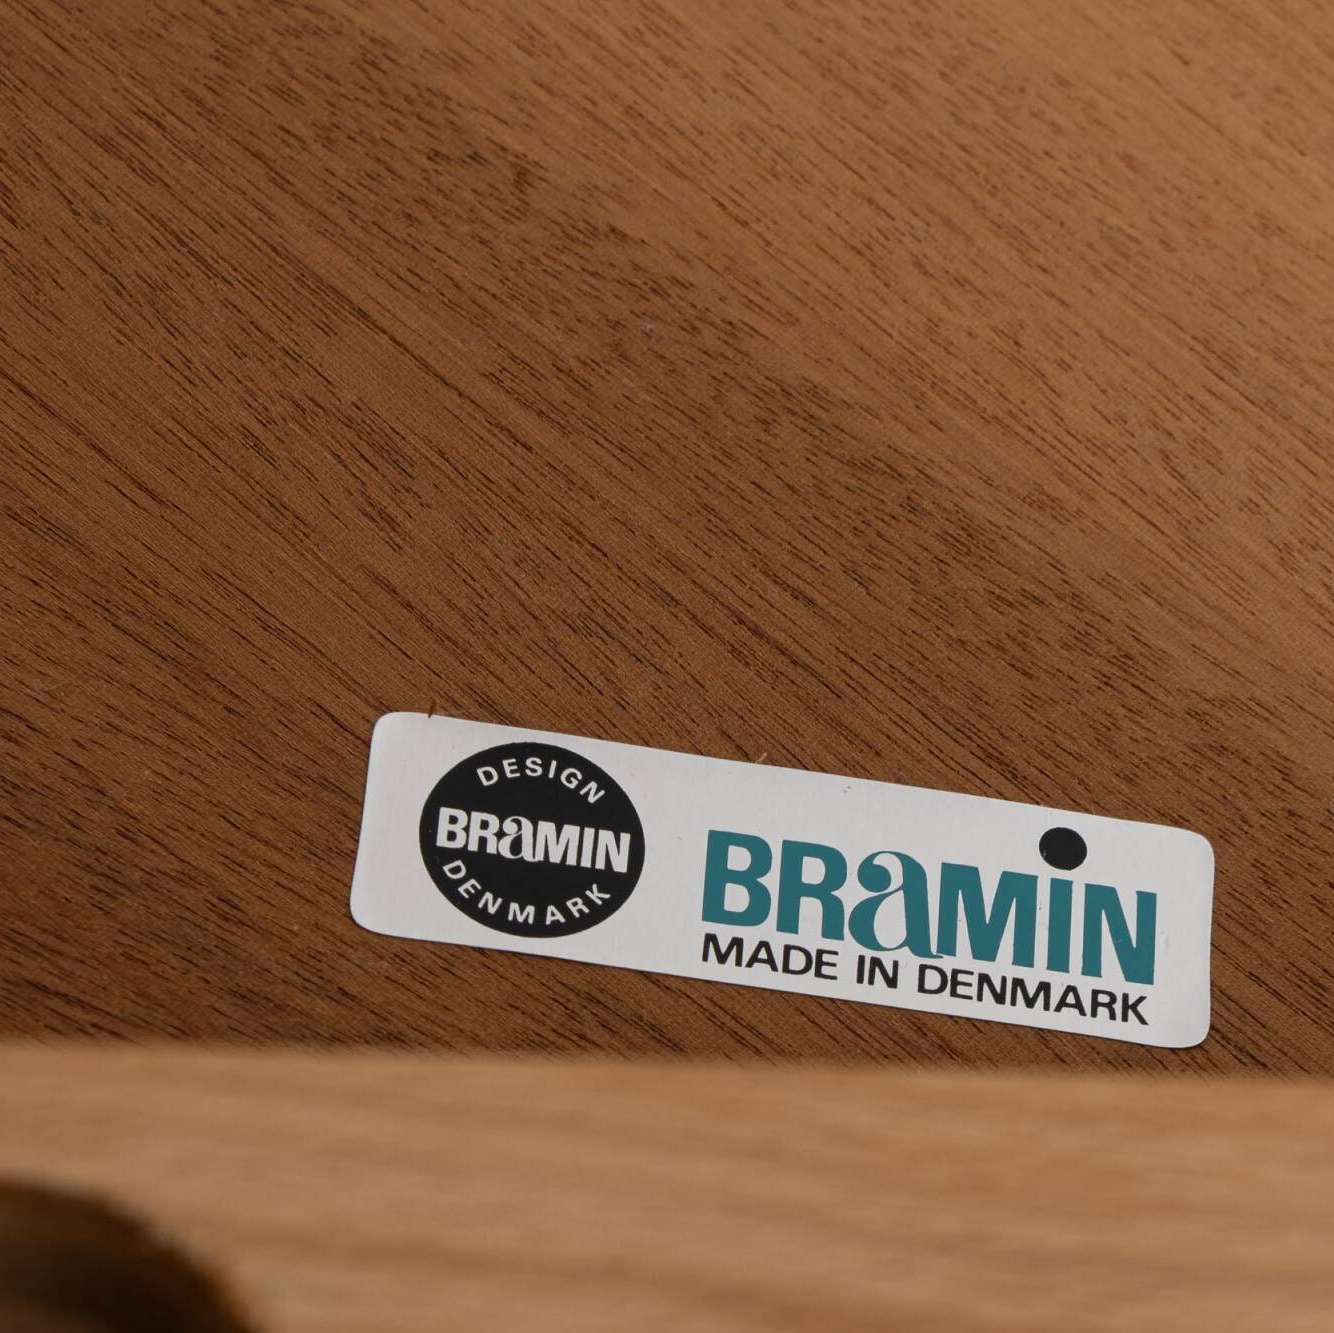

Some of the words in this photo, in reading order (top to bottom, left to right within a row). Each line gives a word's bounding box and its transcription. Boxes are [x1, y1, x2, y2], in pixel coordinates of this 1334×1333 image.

[476, 756, 606, 804] DESIGN
[442, 859, 612, 925] DENMARK
[701, 933, 840, 980] MADE
[856, 955, 900, 989] IN
[917, 964, 1150, 1026] DENMARK
